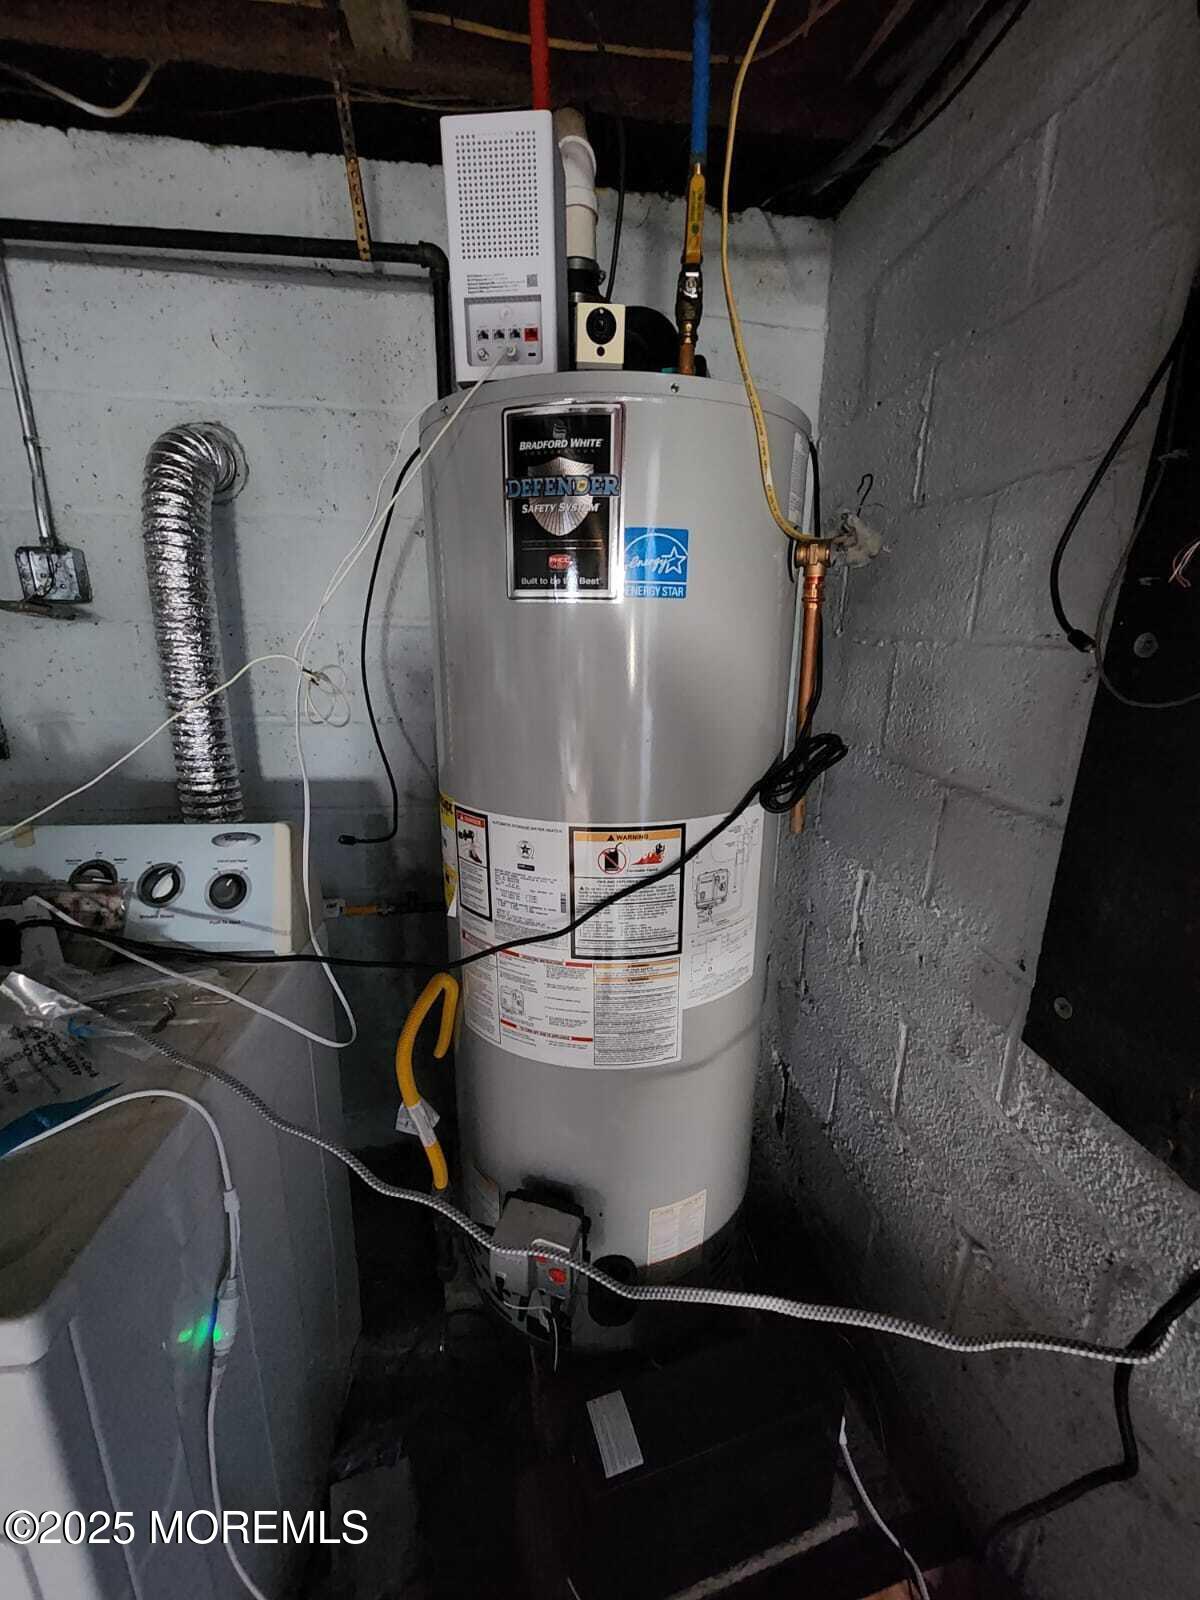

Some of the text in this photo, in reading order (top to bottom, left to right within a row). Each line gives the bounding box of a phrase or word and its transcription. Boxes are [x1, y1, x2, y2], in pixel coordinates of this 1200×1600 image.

[519, 438, 603, 451] BRADFORD WHITE
[506, 476, 621, 498] DEFENDER
[521, 503, 556, 514] SAFETY
[520, 577, 539, 585] Built
[540, 577, 549, 585] to
[579, 576, 600, 585] Best
[626, 585, 684, 597] ENERGY STAR
[616, 833, 649, 841] WARNING
